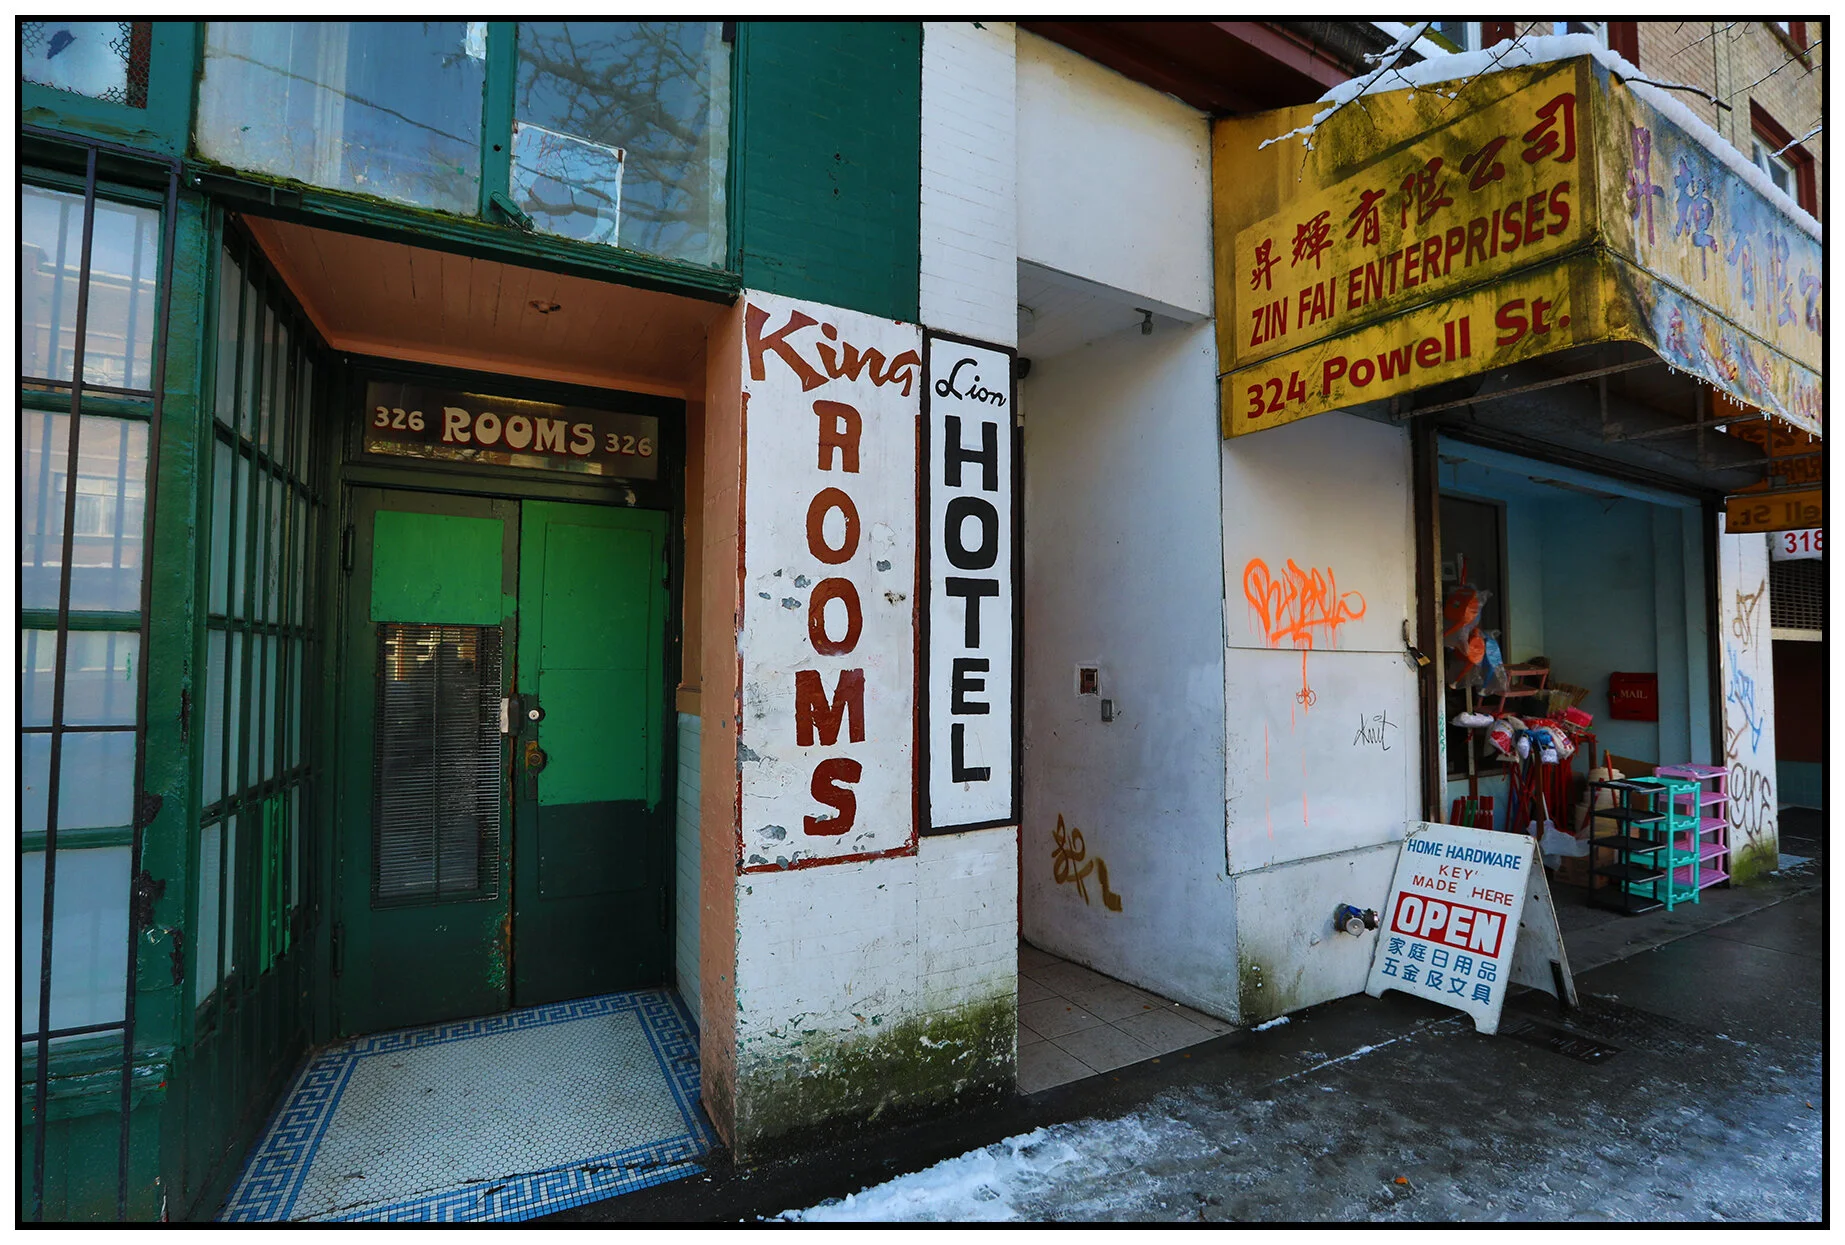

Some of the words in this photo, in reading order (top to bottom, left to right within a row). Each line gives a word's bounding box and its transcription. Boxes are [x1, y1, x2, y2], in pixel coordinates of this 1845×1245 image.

[1250, 297, 1288, 347] ZIN
[1297, 276, 1338, 330] FAI
[1347, 181, 1571, 311] ENTERPRISES
[745, 302, 922, 397] King
[1247, 370, 1306, 419] 324
[1323, 315, 1472, 396] Powell
[1495, 295, 1571, 346] St.
[935, 358, 1007, 407] Lion
[373, 405, 425, 431] 326
[441, 406, 596, 456] ROOMS
[604, 433, 653, 458] 326
[795, 400, 866, 836] ROOMS
[944, 415, 1000, 783] HOTEL
[1620, 690, 1648, 699] MAIL
[1407, 839, 1443, 857] HOME
[1445, 845, 1522, 870] HARDWARE
[1412, 875, 1458, 893] MADE
[1471, 887, 1514, 906] HERE
[1396, 896, 1501, 954] OPEN
[1382, 957, 1492, 1006] 五金及文具
[1388, 937, 1497, 982] 家庭日用品
